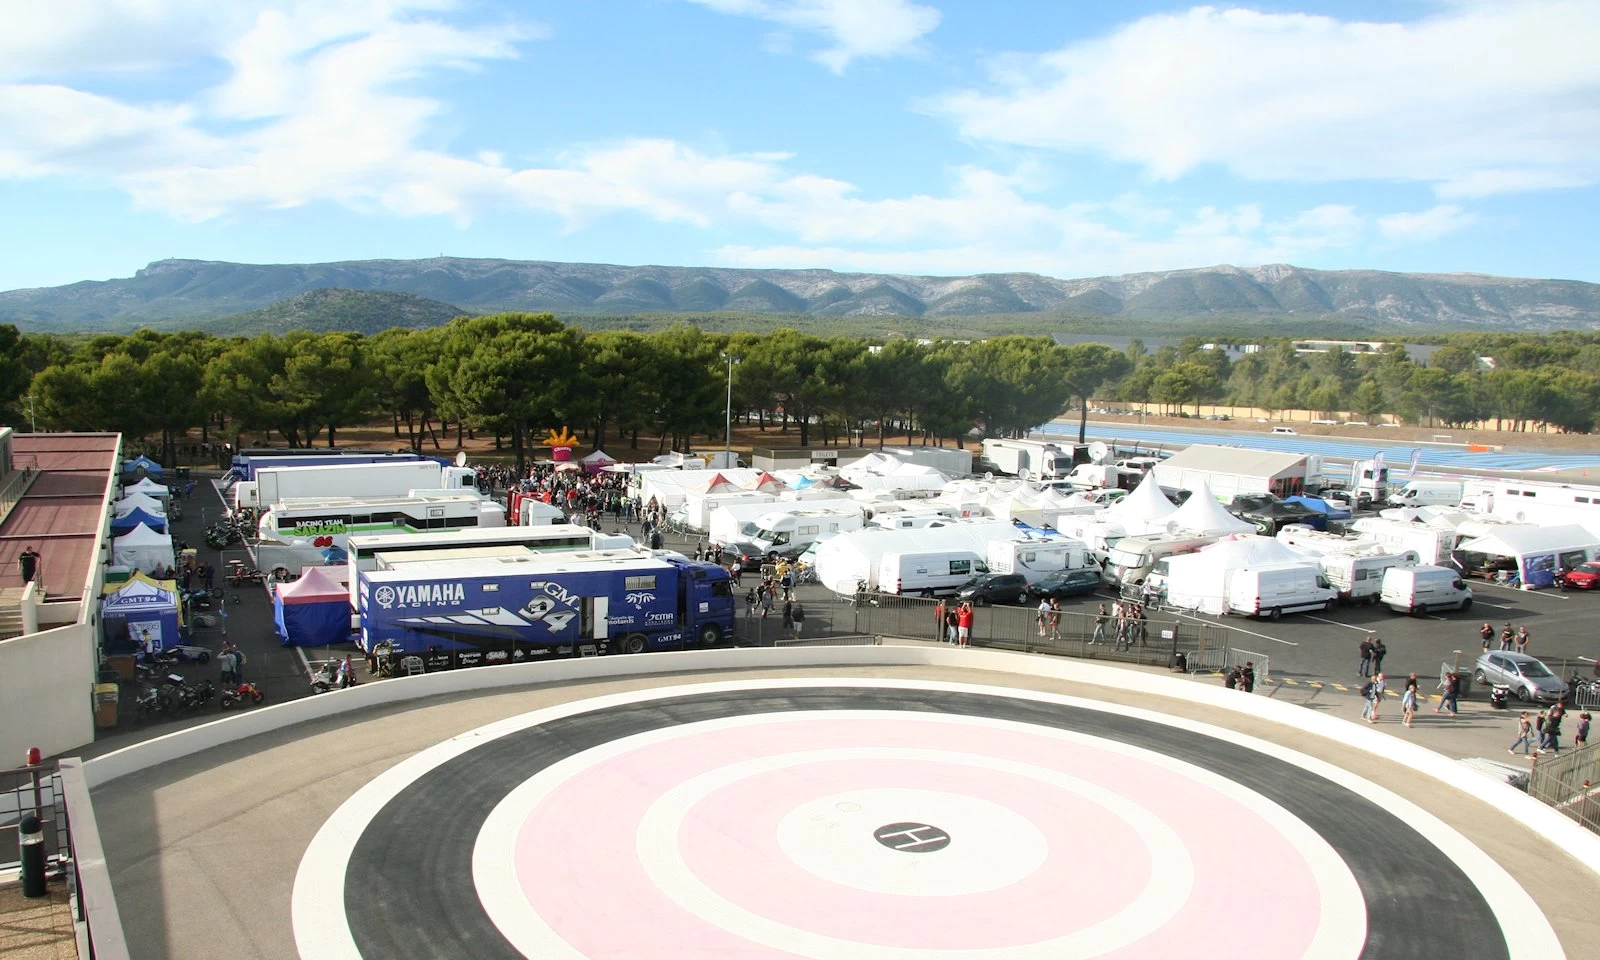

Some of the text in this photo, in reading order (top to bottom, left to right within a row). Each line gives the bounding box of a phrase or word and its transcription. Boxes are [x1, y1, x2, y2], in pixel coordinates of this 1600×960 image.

[294, 524, 346, 536] SARAZIN
[396, 583, 465, 603] YAMAHA
[383, 600, 460, 609] RACING
[518, 594, 576, 634] 94
[879, 825, 948, 850] H
